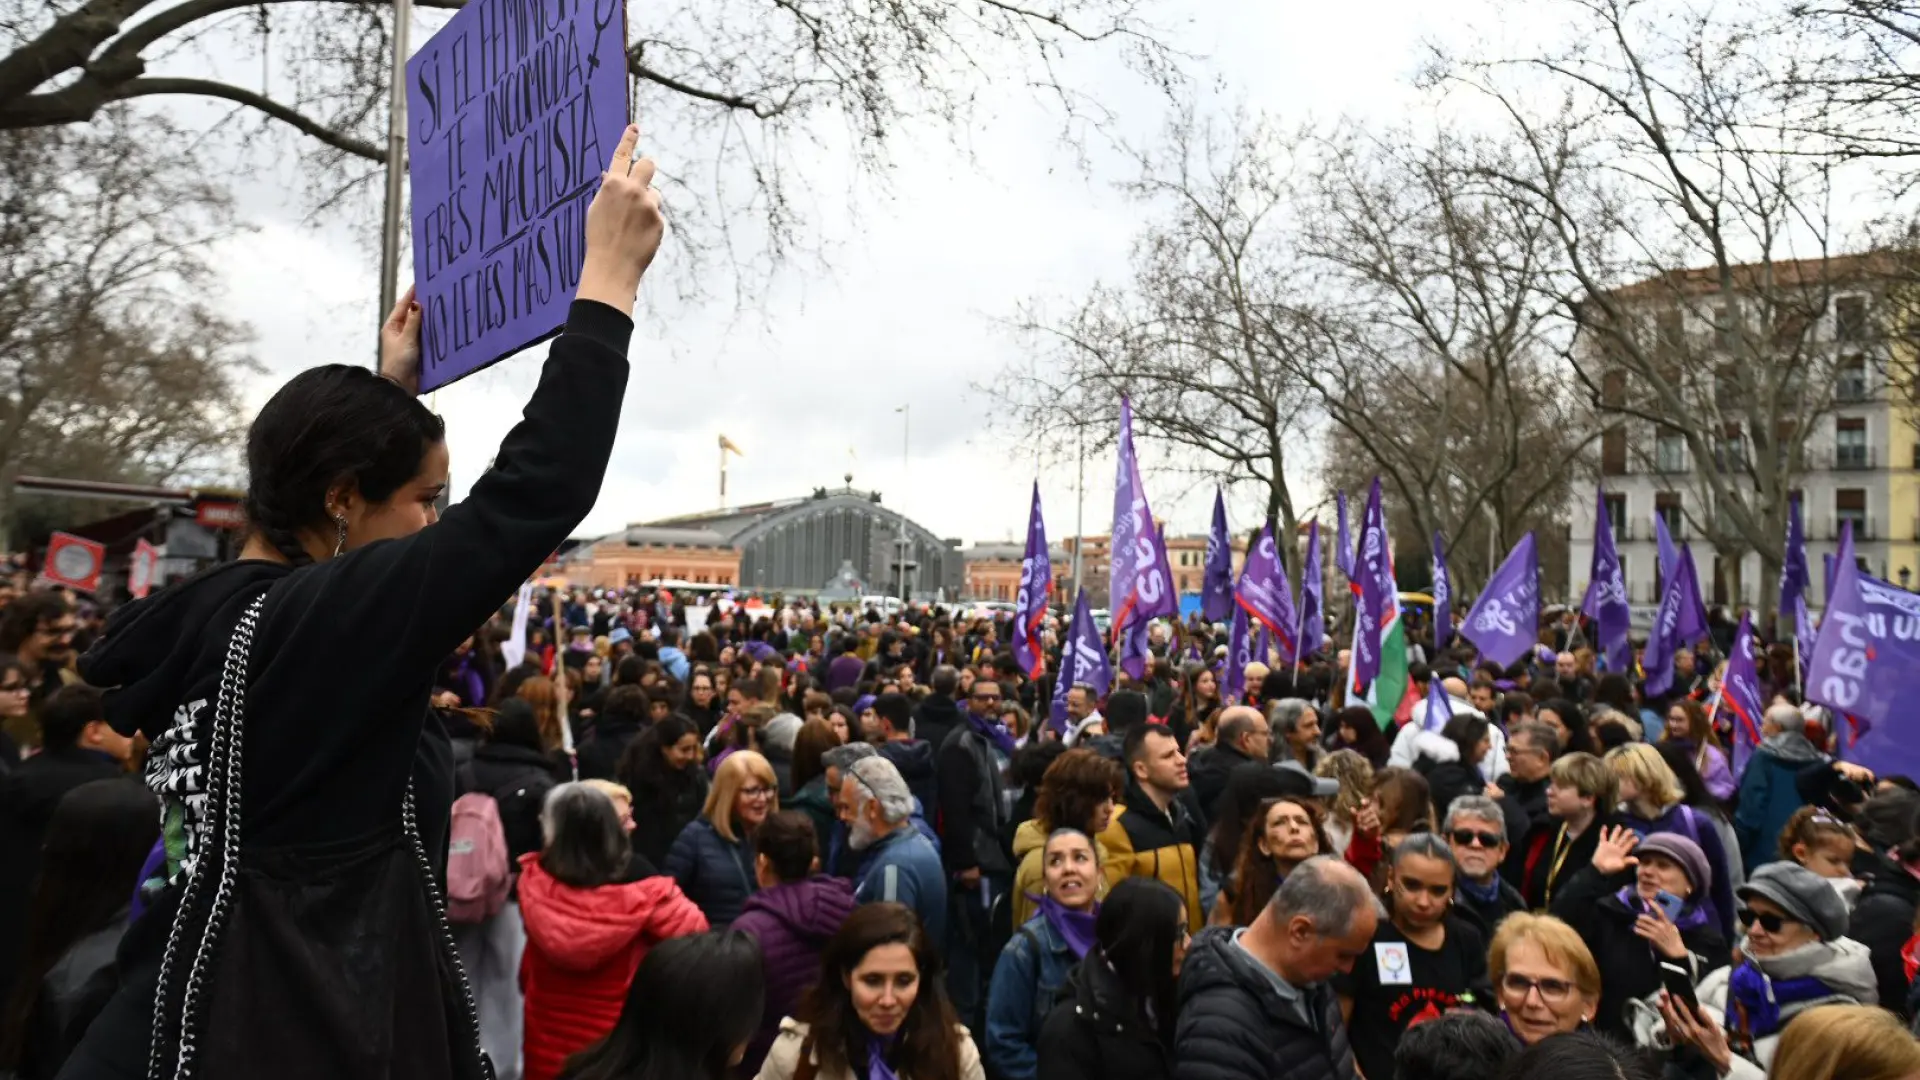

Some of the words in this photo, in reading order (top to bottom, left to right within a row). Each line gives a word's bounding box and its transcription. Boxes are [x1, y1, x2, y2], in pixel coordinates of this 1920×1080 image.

[443, 111, 468, 190] TE
[485, 19, 583, 162] INCOMODA
[452, 30, 477, 115] EL
[425, 184, 473, 282] ERES
[479, 83, 604, 253] MACHISTA
[421, 293, 448, 375] NO
[453, 273, 474, 352] LE
[476, 260, 507, 338] DES
